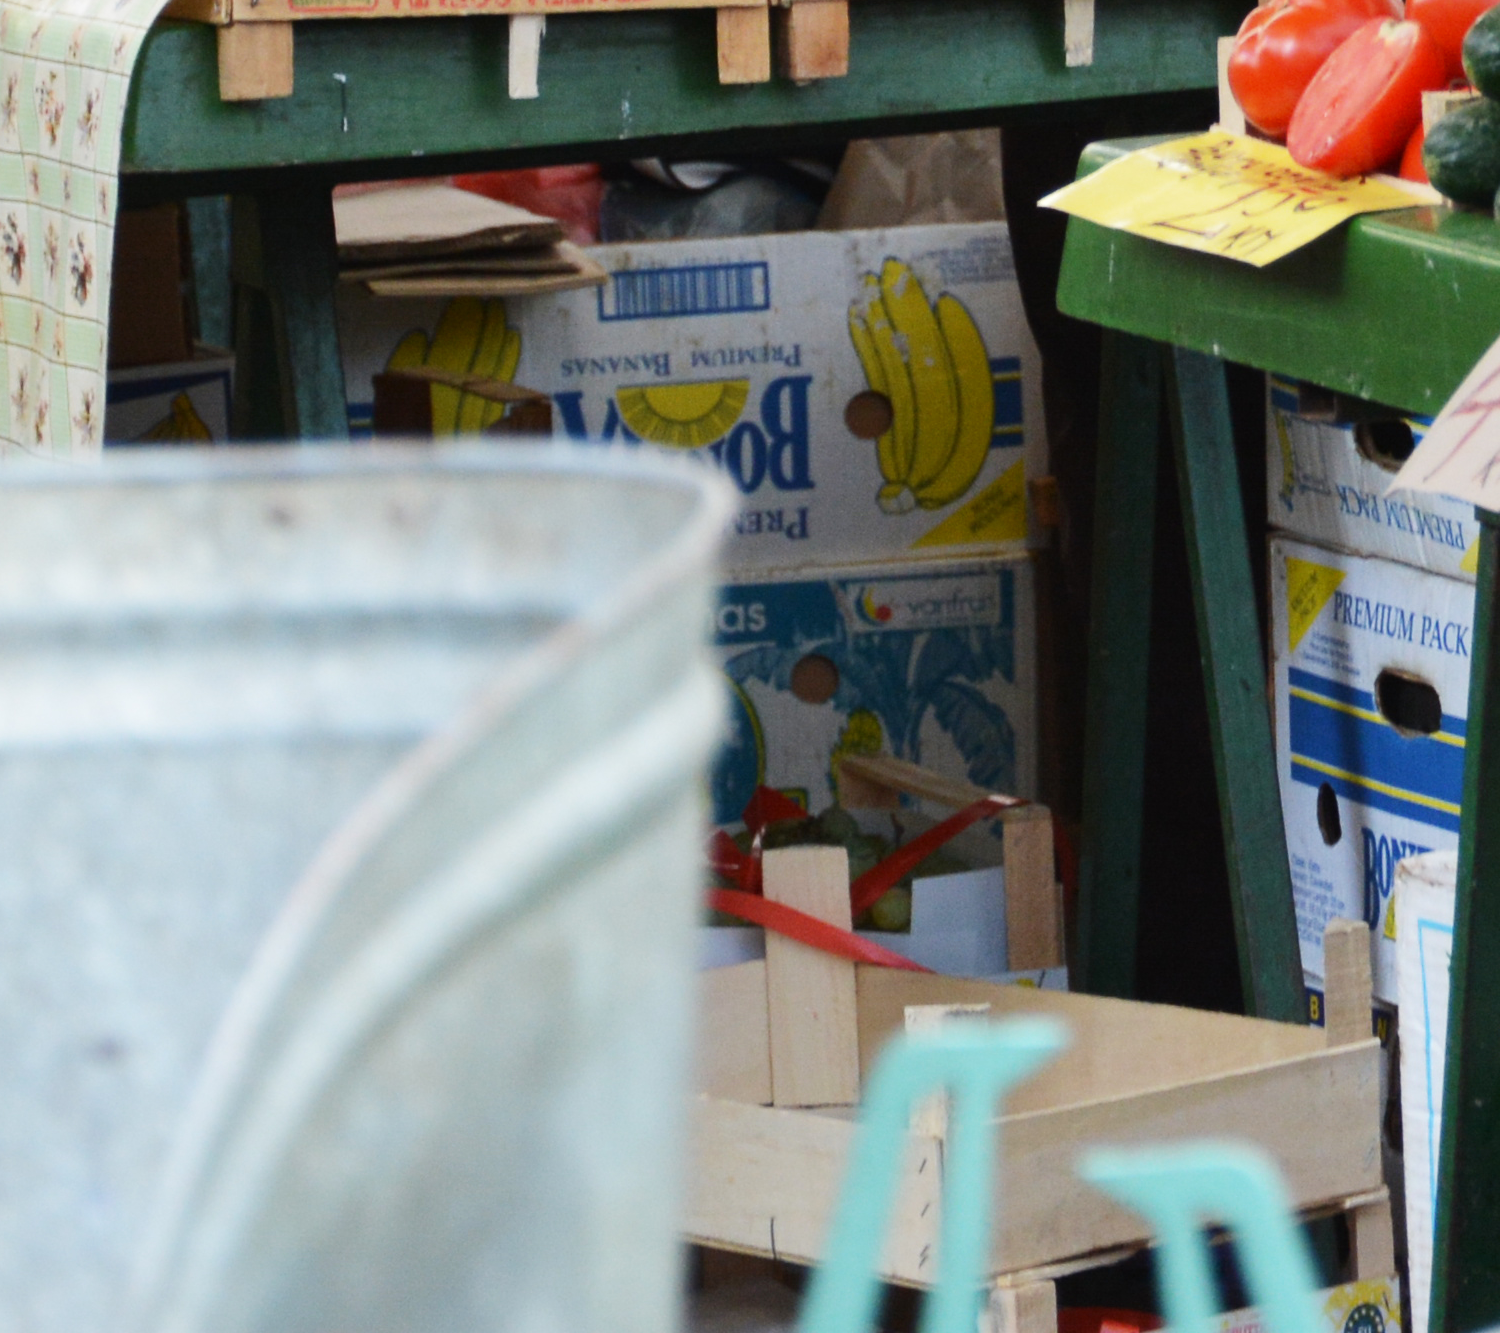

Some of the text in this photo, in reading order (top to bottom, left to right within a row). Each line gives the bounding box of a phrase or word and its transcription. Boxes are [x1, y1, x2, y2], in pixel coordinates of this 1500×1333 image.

[560, 343, 802, 378] PREMIUM BANANAS
[1335, 484, 1381, 524] PACK
[1333, 590, 1470, 657] PREMIUM PACK
